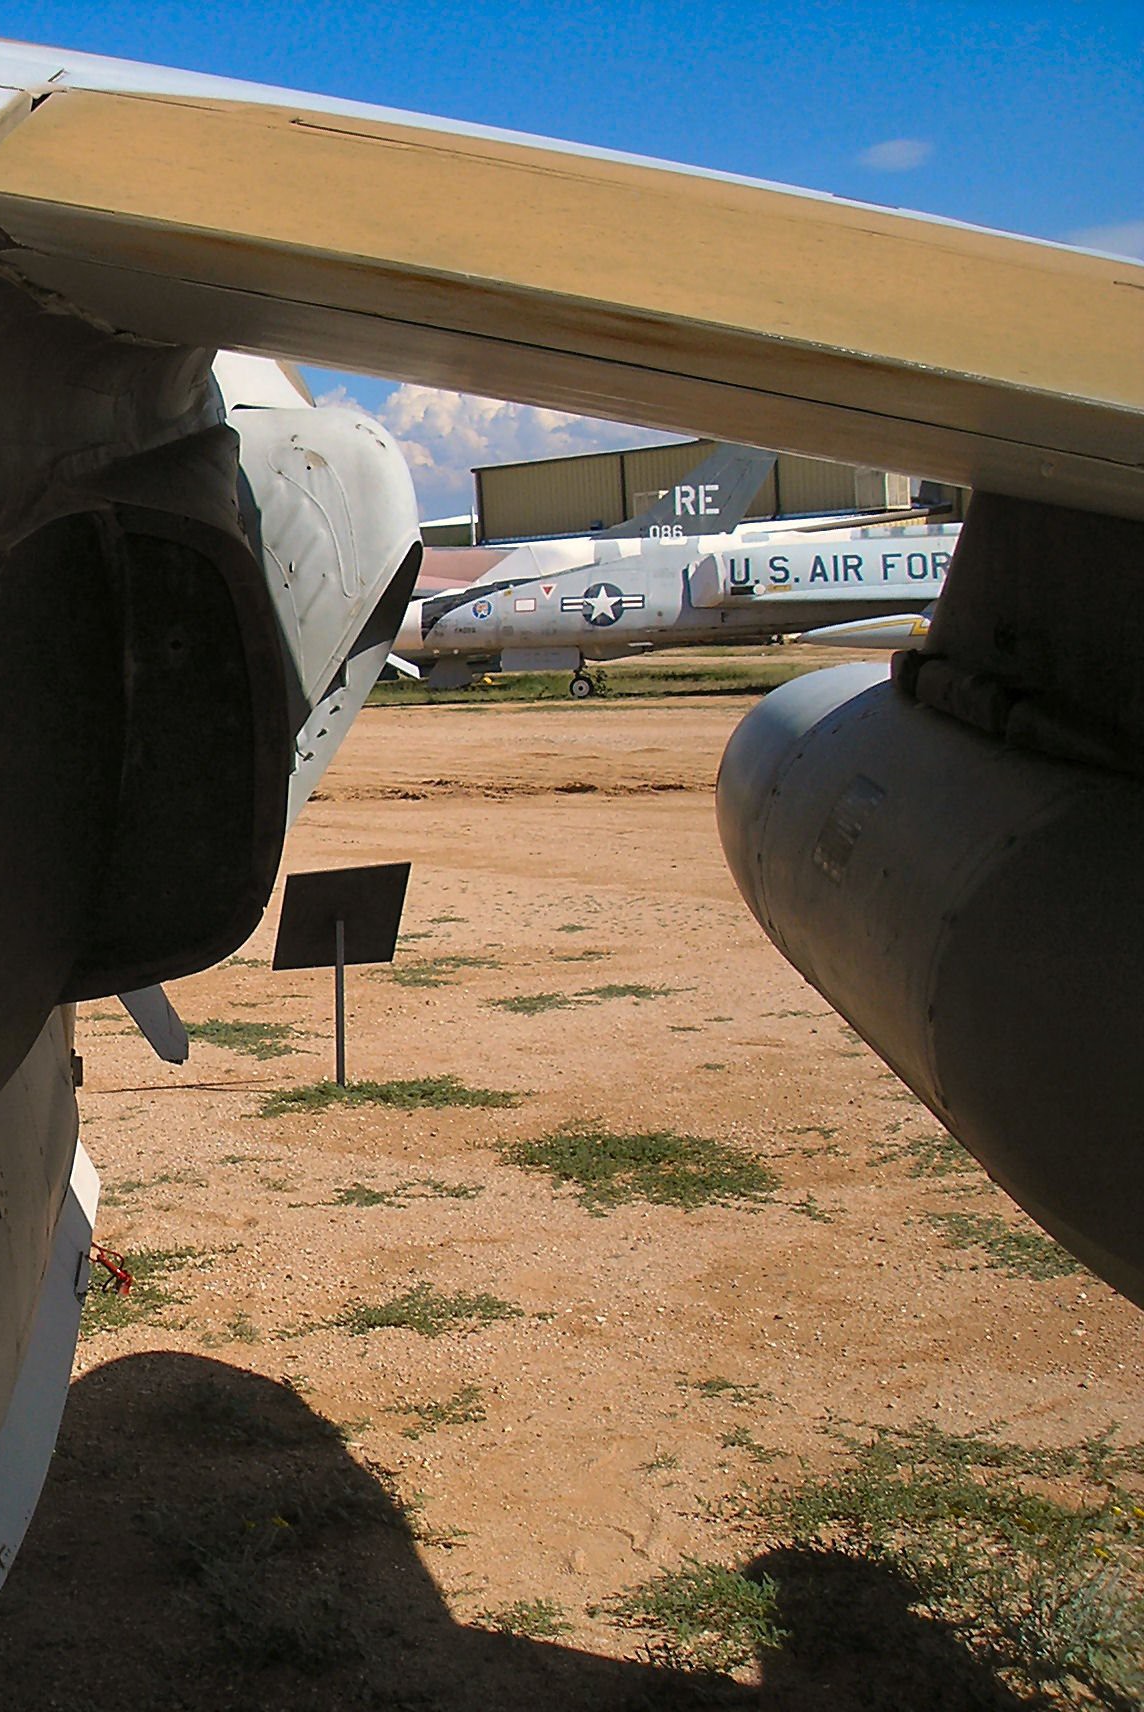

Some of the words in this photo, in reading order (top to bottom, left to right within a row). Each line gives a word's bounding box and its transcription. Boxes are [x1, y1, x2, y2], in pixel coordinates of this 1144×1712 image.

[674, 485, 720, 515] RE
[649, 525, 684, 539] 086
[729, 556, 800, 585] U.S.
[809, 554, 864, 583] AIR
